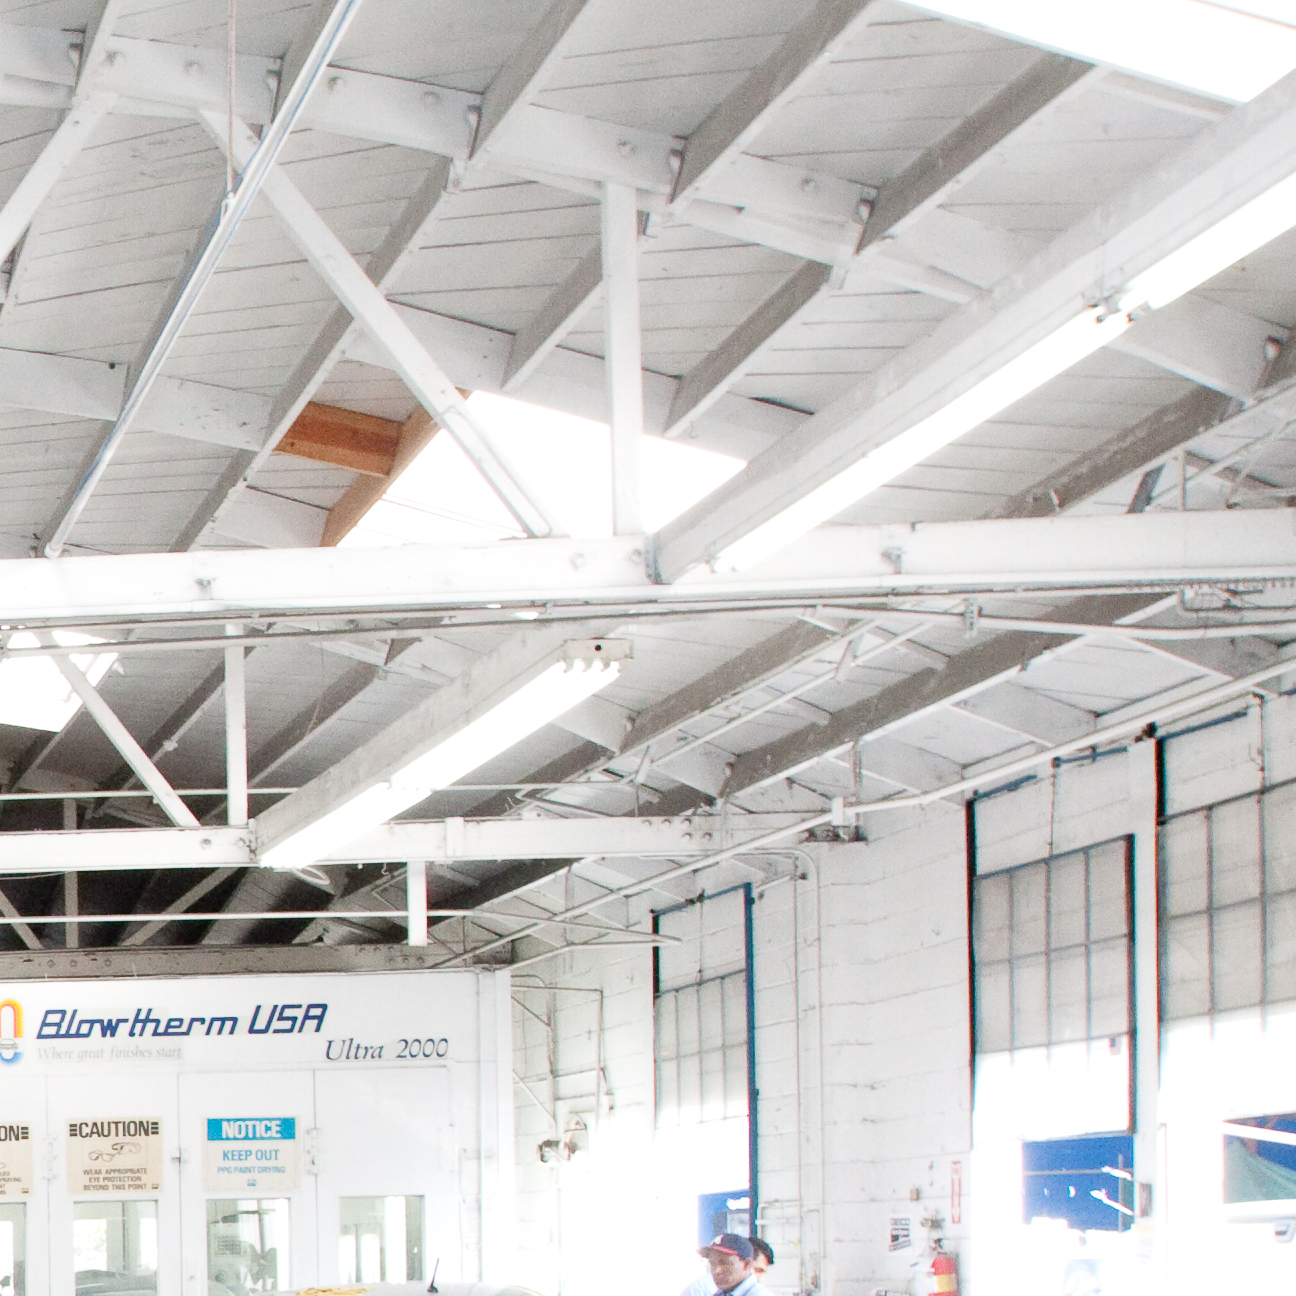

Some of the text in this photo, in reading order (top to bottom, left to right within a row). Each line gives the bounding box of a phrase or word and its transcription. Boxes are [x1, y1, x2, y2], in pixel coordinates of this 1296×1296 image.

[36, 1003, 328, 1039] Blowtherm USA
[37, 1046, 74, 1060] Where
[77, 1047, 105, 1063] great
[108, 1045, 153, 1062] finishes
[324, 1037, 449, 1061] Ultra 2000
[79, 1121, 150, 1138] CAUTION
[221, 1120, 282, 1138] NOTICE
[222, 1149, 279, 1161] KEEP OUT
[105, 1167, 147, 1175] APPROPRIATE
